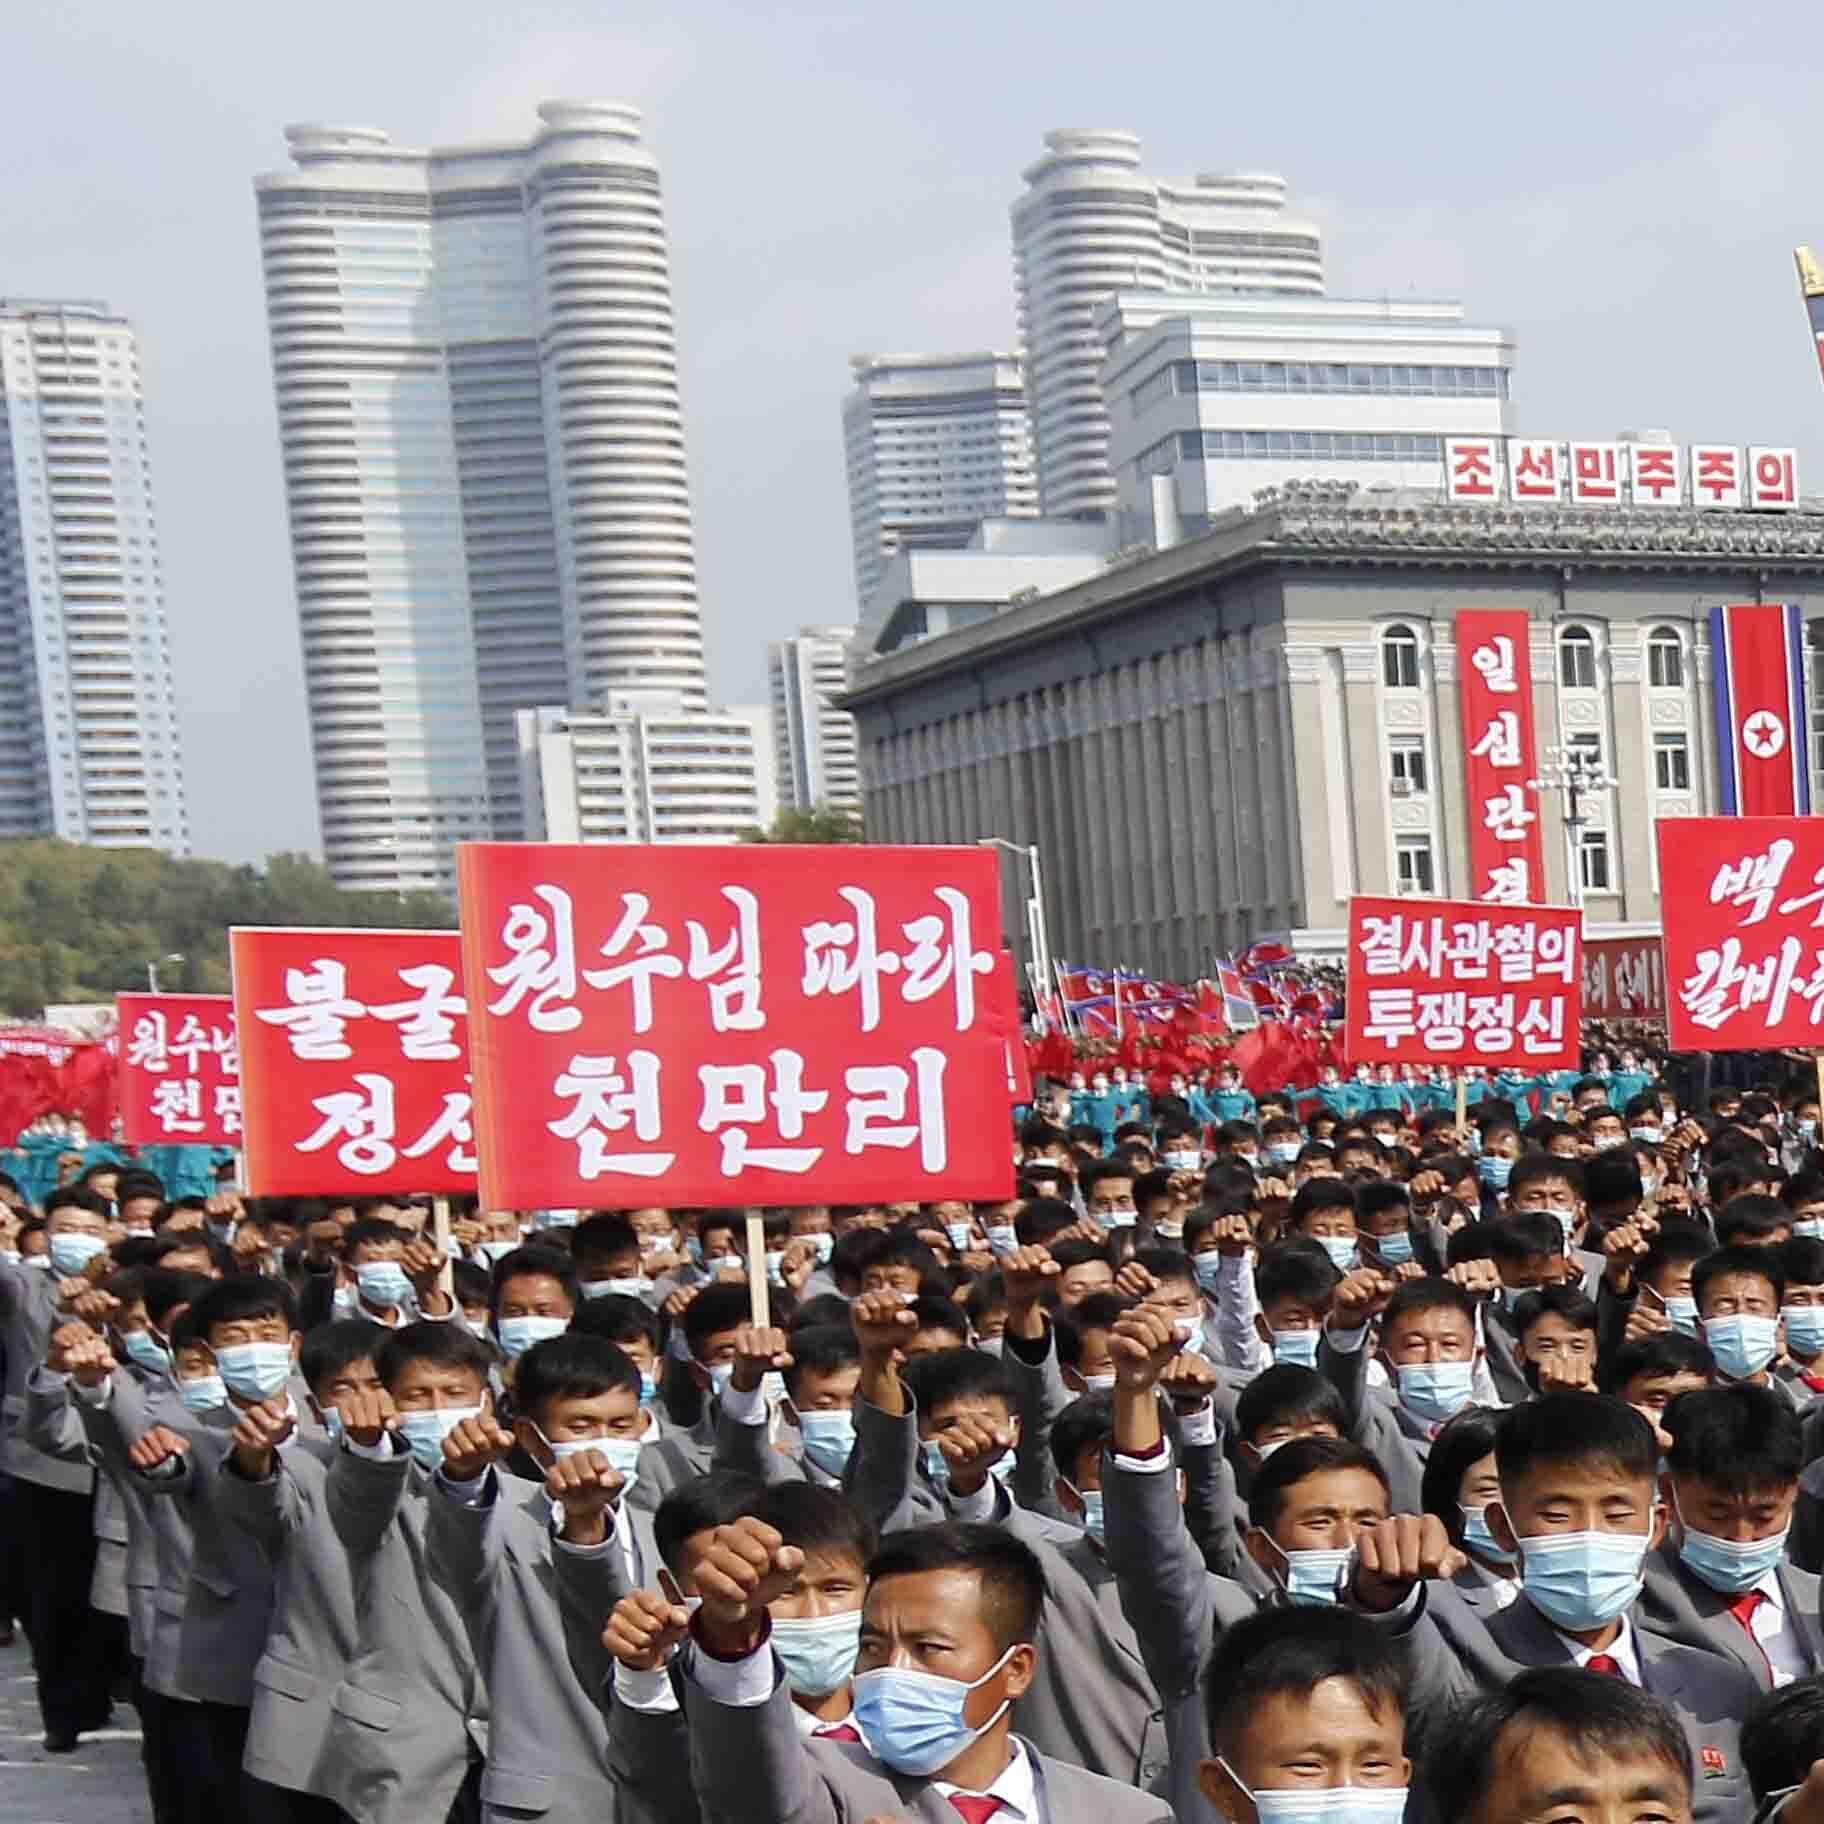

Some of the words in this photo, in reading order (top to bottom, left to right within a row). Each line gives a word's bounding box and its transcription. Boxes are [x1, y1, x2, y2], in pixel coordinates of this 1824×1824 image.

[1454, 445, 1795, 503] 조선민주주의
[487, 883, 767, 1034] 원수님
[801, 885, 995, 1033] 따라
[1359, 915, 1576, 985] 결사관철의
[1363, 988, 1565, 1055] 투쟁정신
